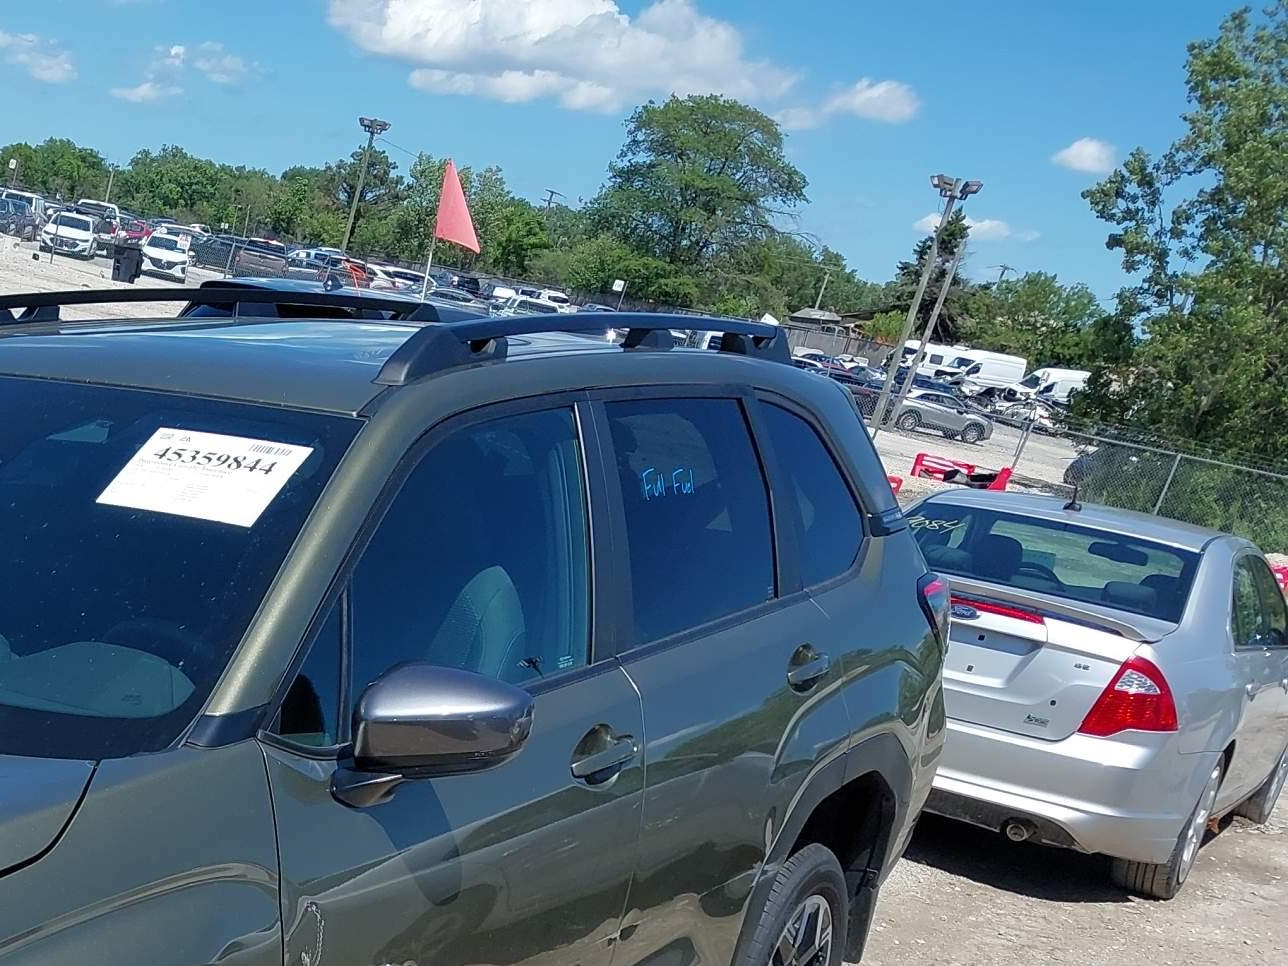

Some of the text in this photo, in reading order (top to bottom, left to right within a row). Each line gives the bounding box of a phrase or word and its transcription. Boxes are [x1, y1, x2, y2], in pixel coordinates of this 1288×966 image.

[153, 446, 278, 475] 45359844
[642, 468, 694, 501] Full Fuel
[952, 605, 973, 616] Ford
